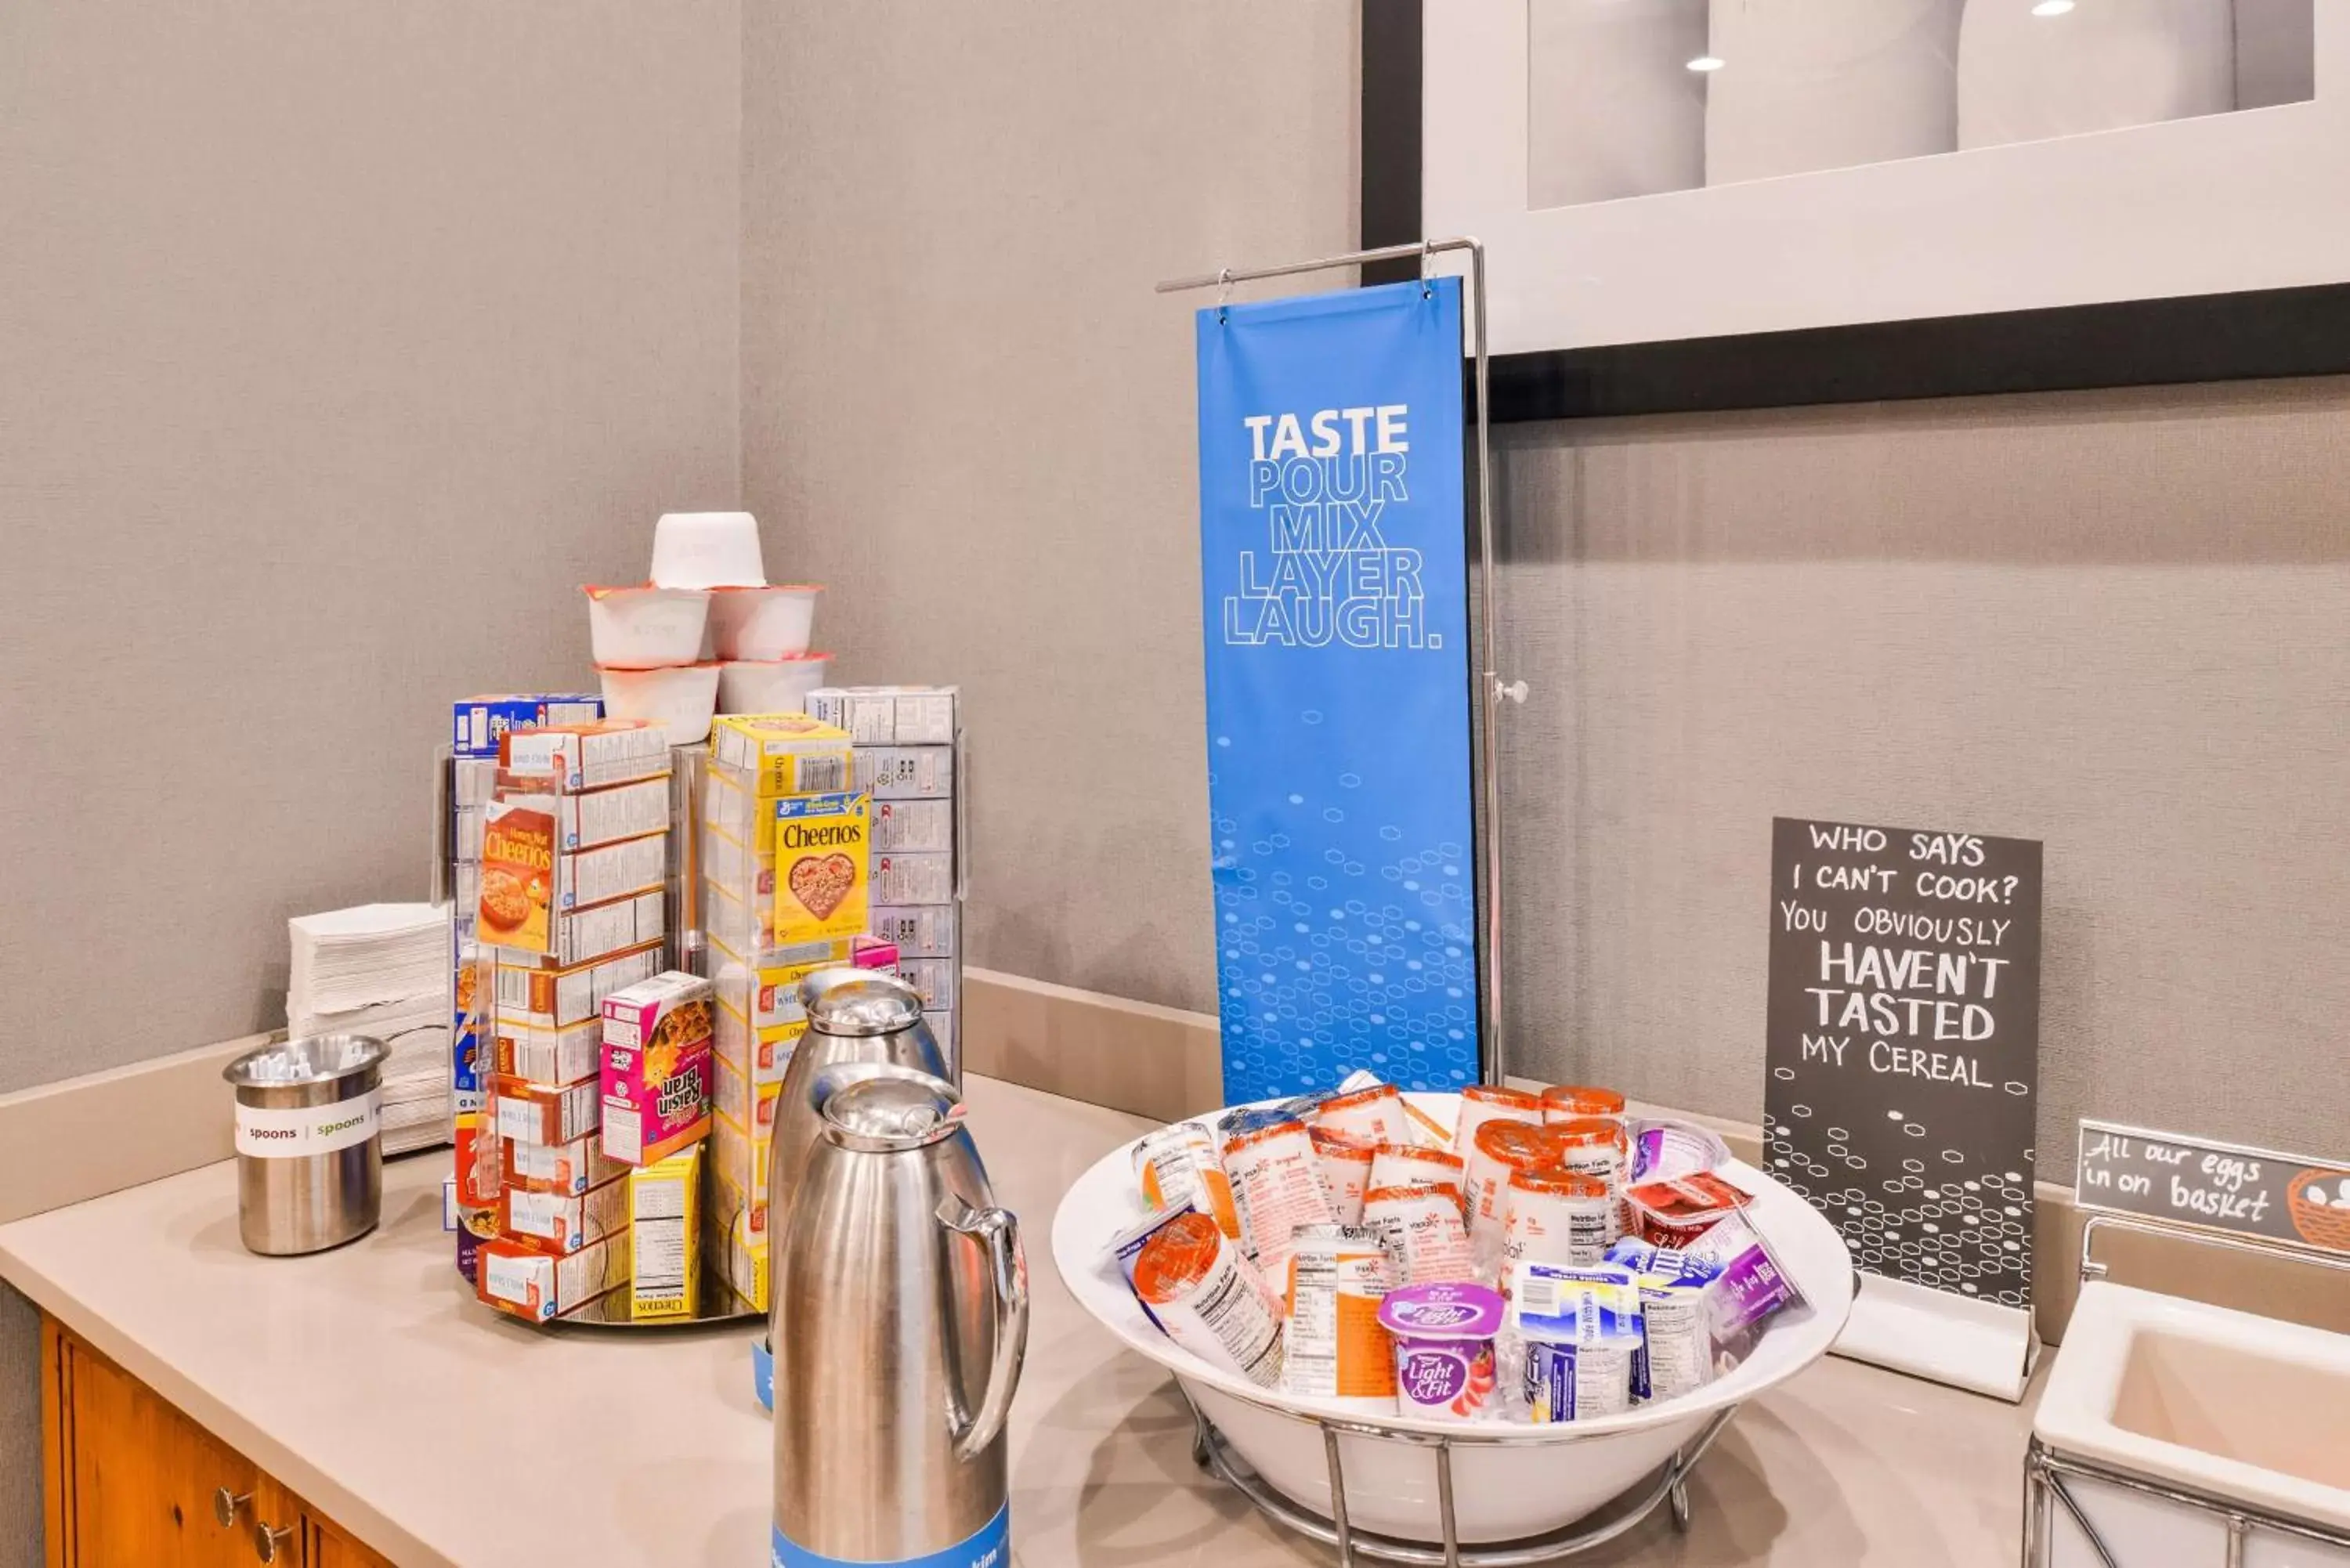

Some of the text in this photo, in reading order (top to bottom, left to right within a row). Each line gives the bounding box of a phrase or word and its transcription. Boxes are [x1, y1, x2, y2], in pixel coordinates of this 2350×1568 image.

[1244, 404, 1409, 462] TASTE
[1249, 452, 1408, 508] POUR
[1270, 500, 1386, 554] MIX
[1240, 548, 1424, 599] LAYER
[1224, 596, 1442, 649] LAUGH.
[486, 831, 551, 870] Cheerios
[783, 823, 862, 848] Cheerios
[1809, 824, 1985, 867] WHO SAYS
[1793, 863, 2019, 905] I CAN'T COOK?
[1781, 899, 2012, 946] YOU OBVIOUSLY
[1820, 940, 2010, 999] HAVEN'T
[1804, 988, 1995, 1041] TASTED
[662, 1064, 700, 1097] Bran
[1802, 1032, 1994, 1088] MY CEREAL
[657, 1078, 703, 1117] Raisin
[250, 1114, 364, 1140] spoons spoons
[2084, 1135, 2261, 1191] All our eggs
[2083, 1159, 2270, 1222] in on basket
[638, 1300, 683, 1311] Cheerios
[1409, 1361, 1454, 1384] Light
